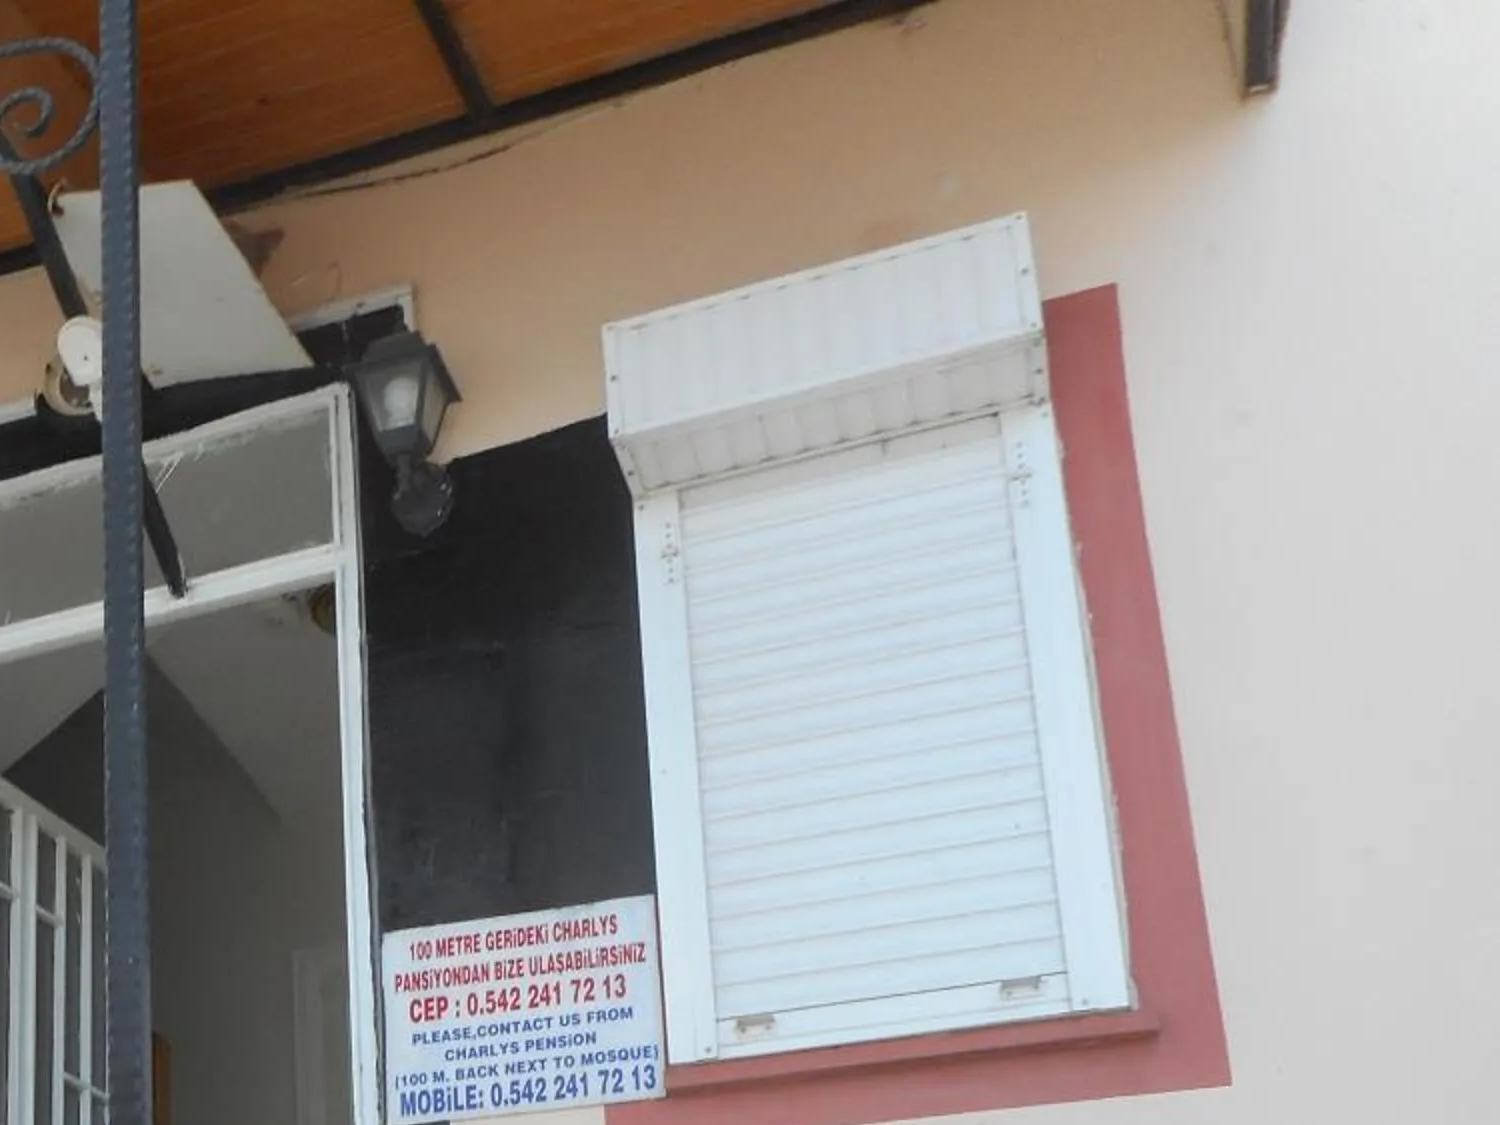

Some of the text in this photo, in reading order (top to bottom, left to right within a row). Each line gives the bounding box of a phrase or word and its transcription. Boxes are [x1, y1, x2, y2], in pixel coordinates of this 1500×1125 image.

[410, 940, 432, 960] 100
[436, 933, 481, 957] METRE
[553, 915, 618, 941] CHARLYS
[409, 998, 449, 1023] CEP
[467, 988, 520, 1016] 0.542
[528, 982, 561, 1008] 241
[571, 978, 595, 1002] 72
[603, 974, 627, 999] 13
[560, 1013, 581, 1026] US
[587, 1007, 633, 1023] FROM
[445, 1041, 519, 1061] CHARLYS
[432, 1070, 449, 1082] M.
[456, 1064, 498, 1081] BACK
[504, 1059, 546, 1075] NEXT
[554, 1056, 573, 1068] TO
[491, 1079, 547, 1107] 0.542
[555, 1074, 588, 1099] 241
[598, 1070, 623, 1094] 72
[632, 1065, 656, 1089] 13
